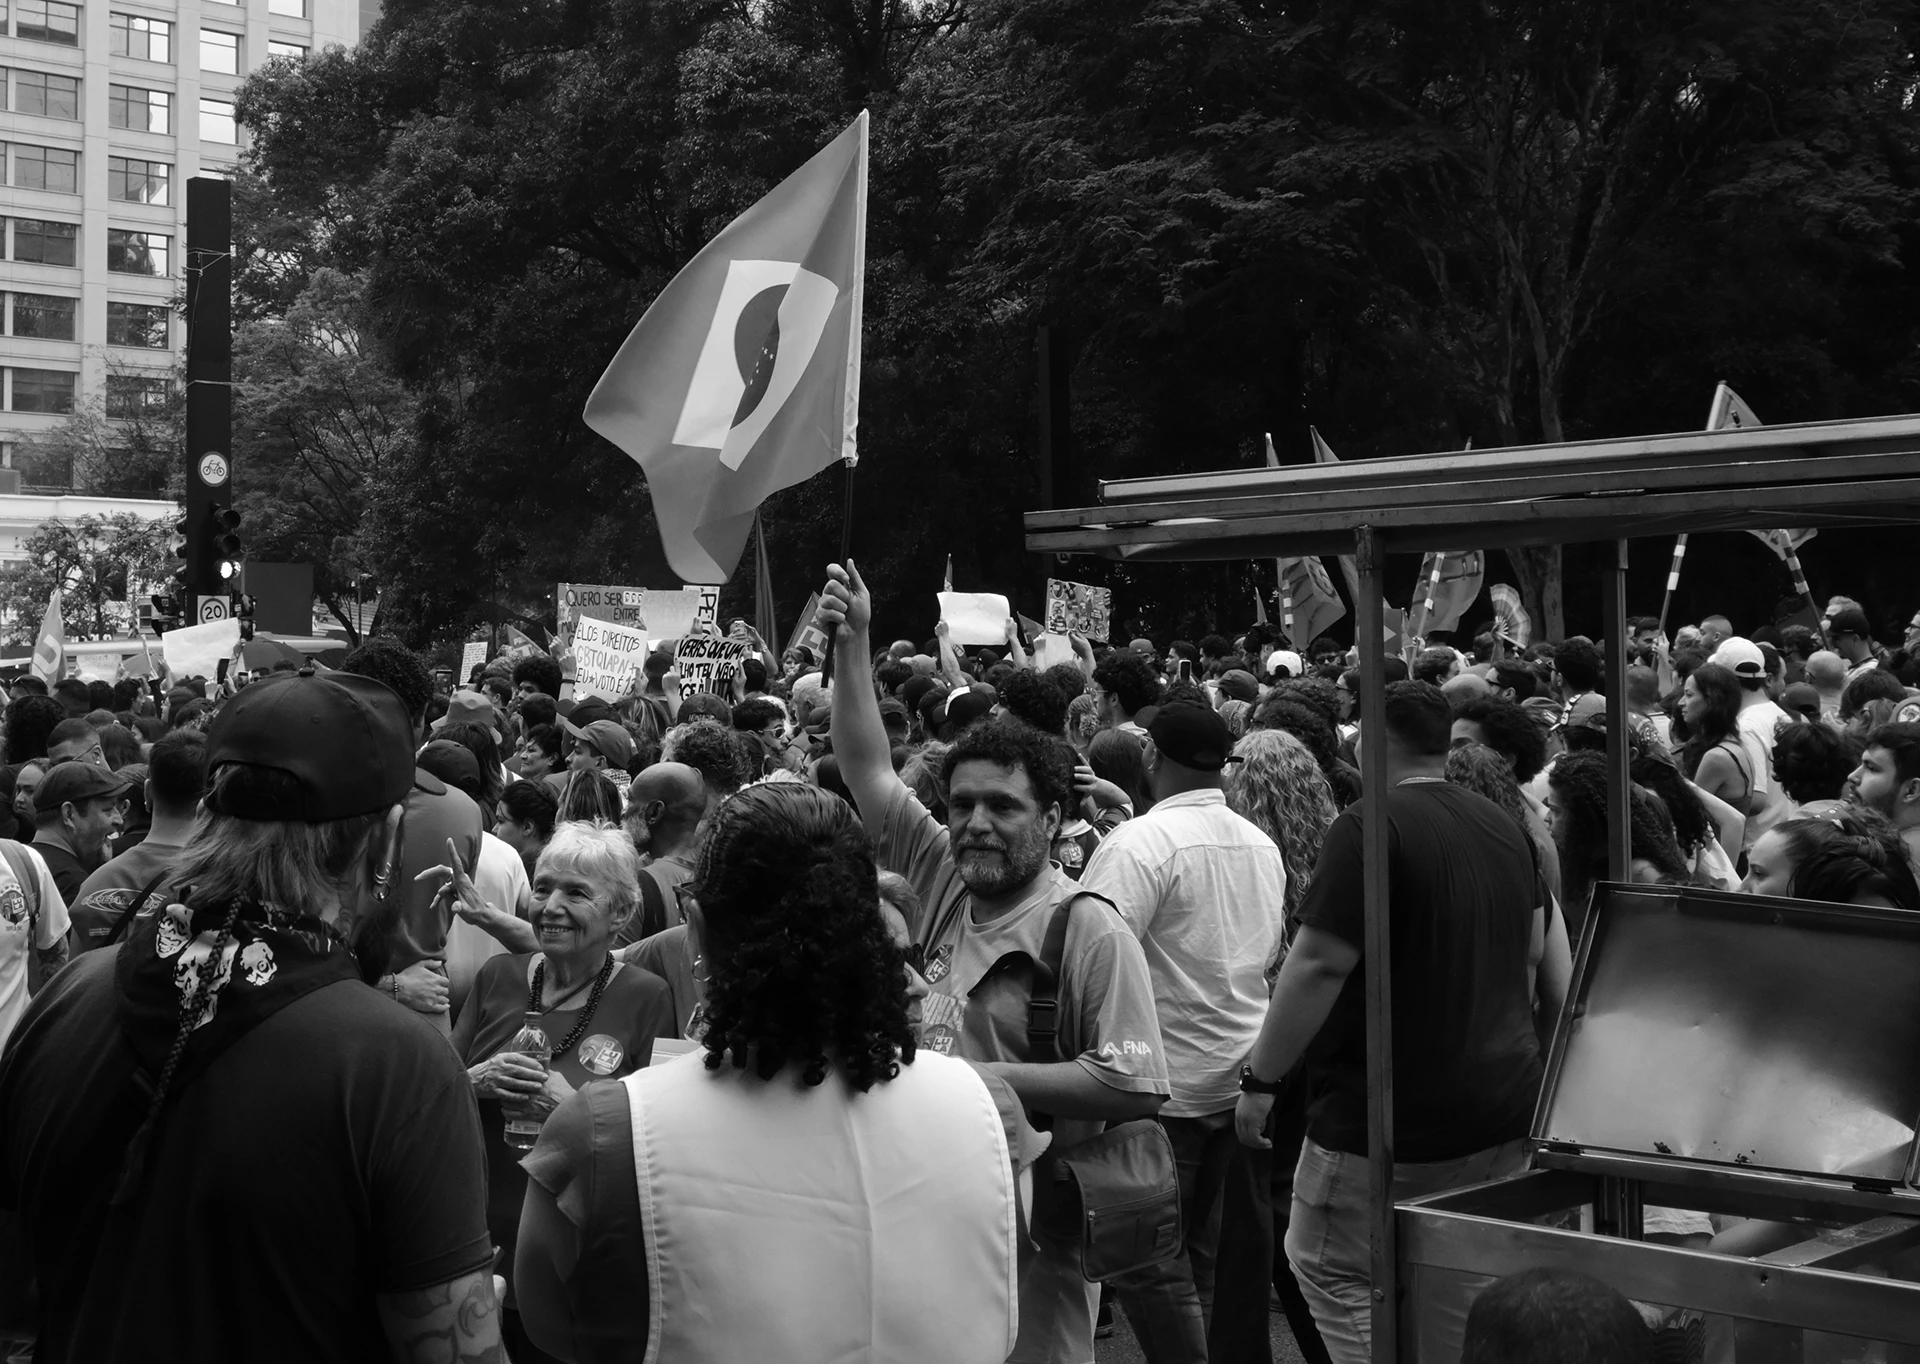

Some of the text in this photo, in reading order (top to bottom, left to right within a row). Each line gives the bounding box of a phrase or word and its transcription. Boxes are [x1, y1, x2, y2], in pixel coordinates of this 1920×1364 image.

[566, 589, 624, 607] QUERO SER
[204, 604, 222, 620] 20
[613, 607, 640, 621] ENTRE
[695, 662, 714, 679] TEU
[714, 661, 735, 679] NÃO
[1122, 1040, 1152, 1056] FNA
